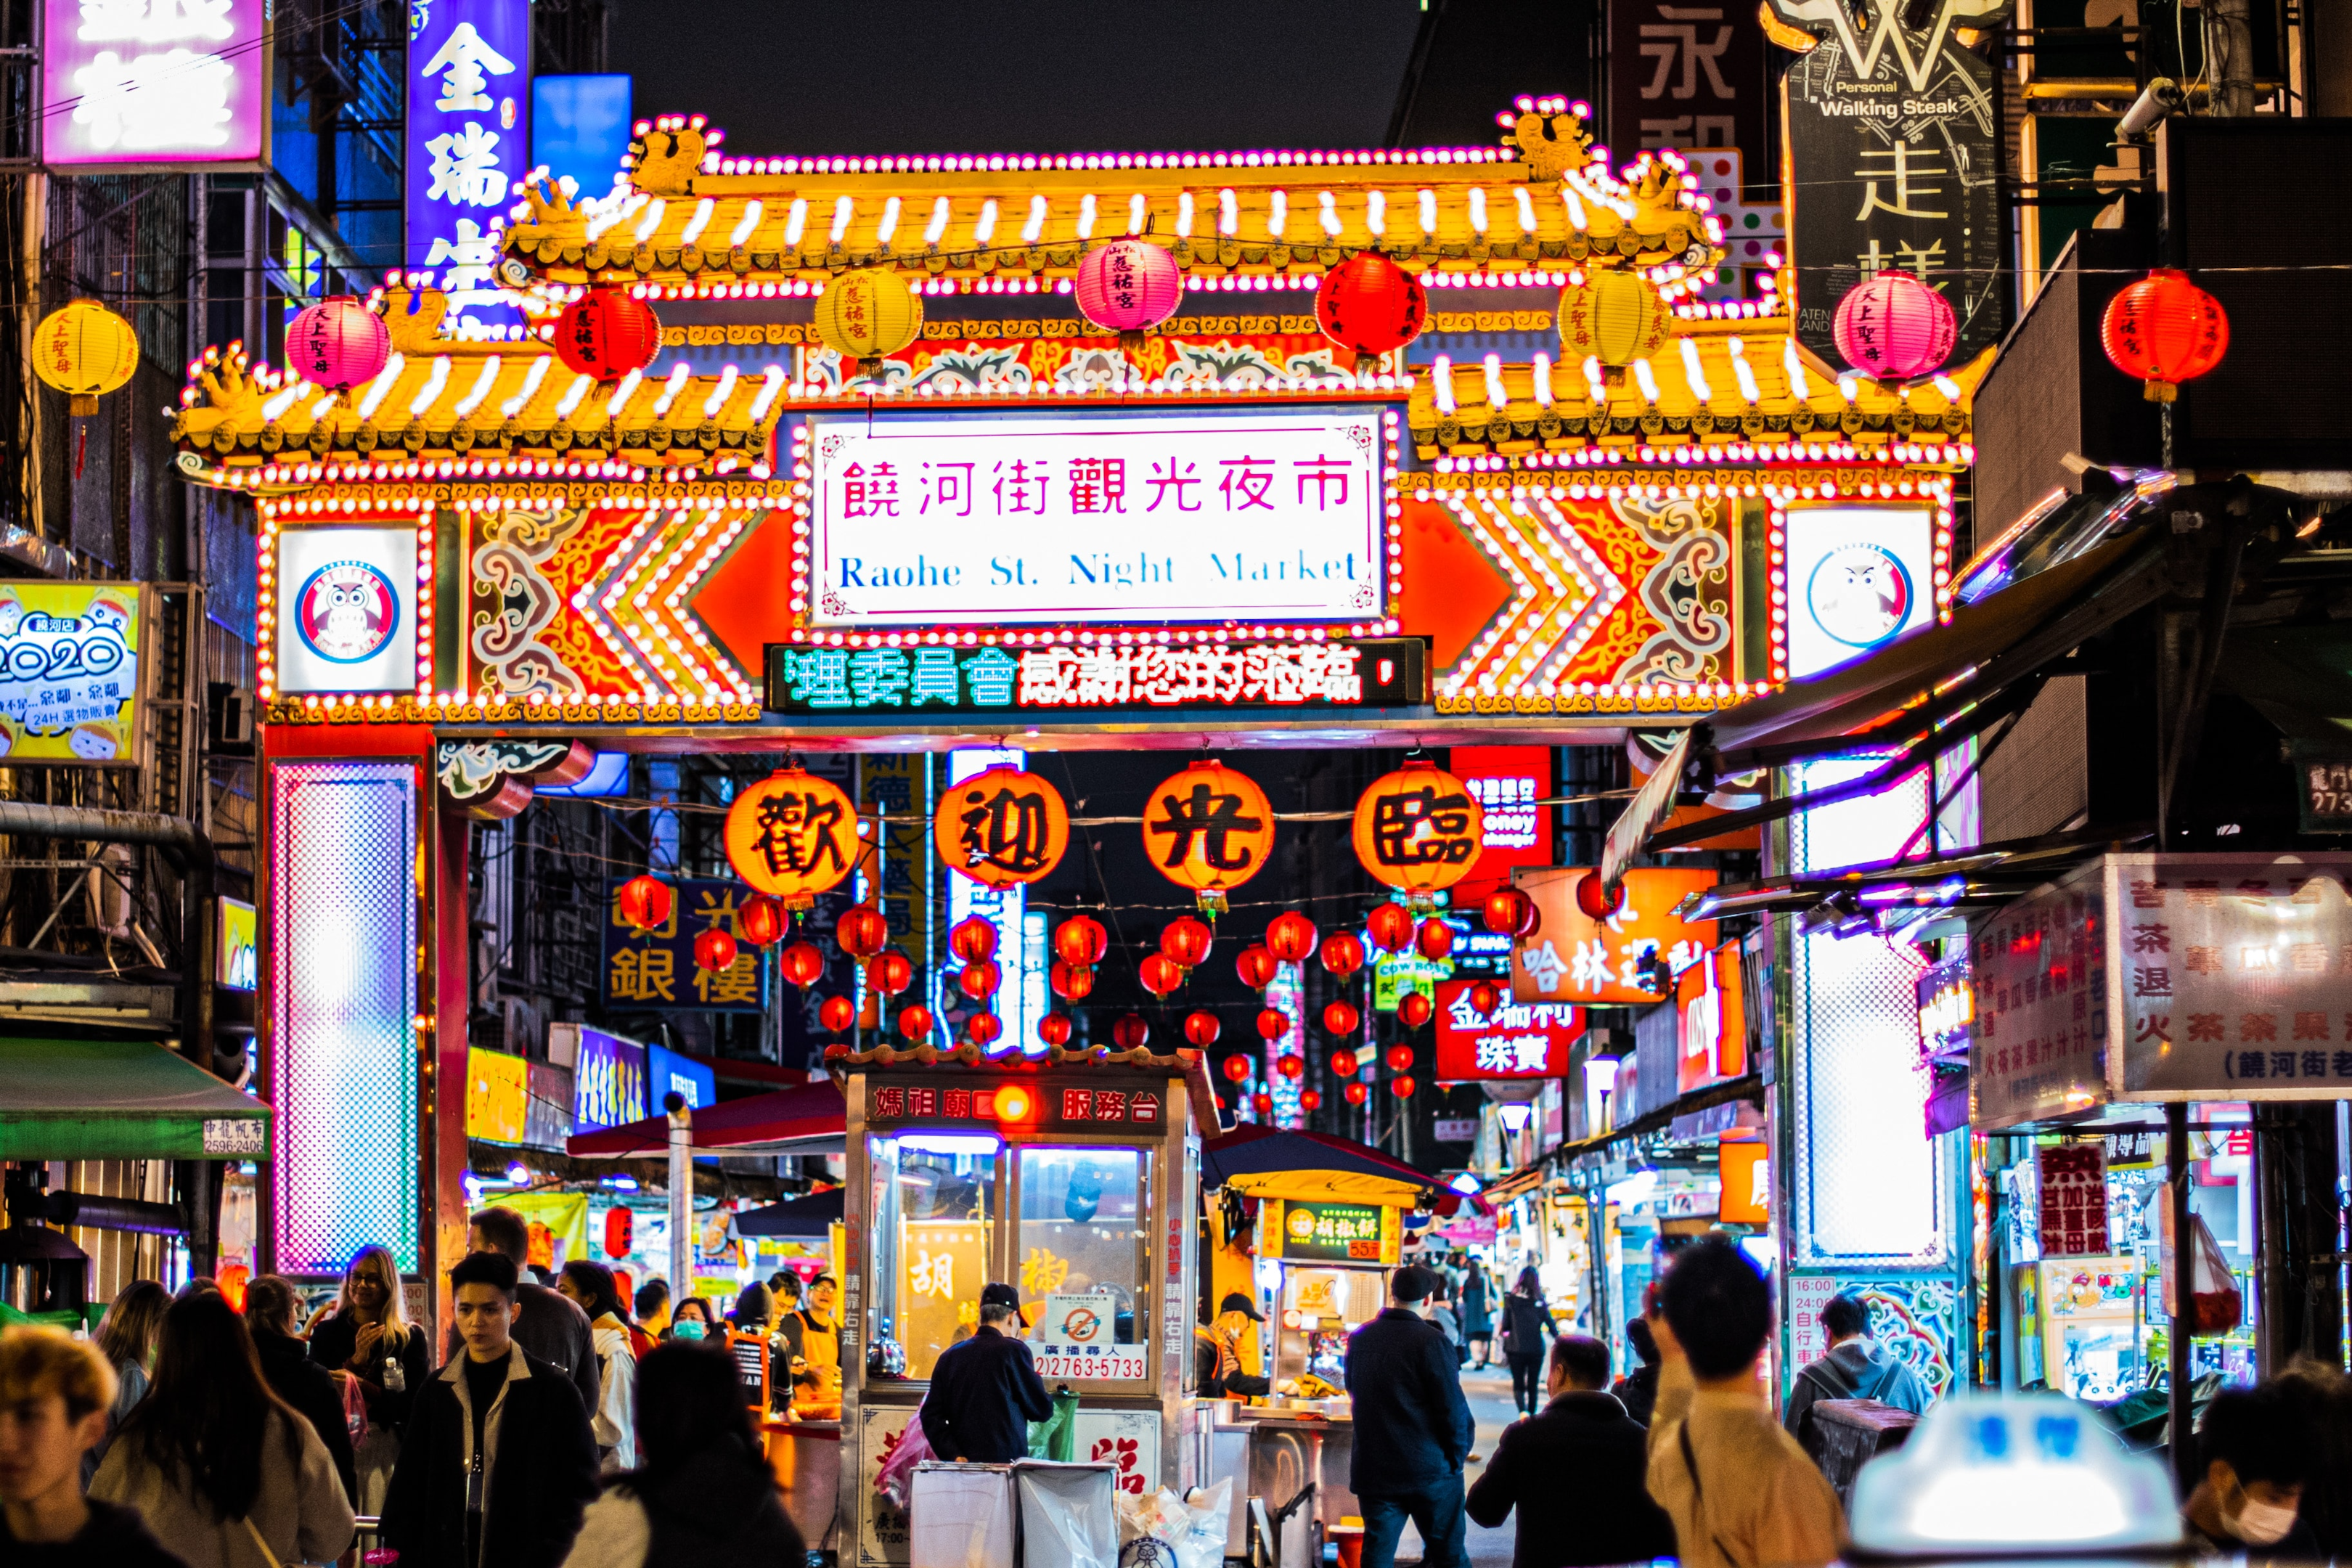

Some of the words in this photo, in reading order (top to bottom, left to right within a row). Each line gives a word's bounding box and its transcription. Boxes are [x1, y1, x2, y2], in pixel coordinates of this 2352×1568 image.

[1819, 98, 1898, 119] Walking
[1903, 98, 1959, 114] Steak
[1836, 81, 1898, 93] Personal
[1570, 279, 1594, 346] 天上聖母
[1856, 287, 1882, 362] 天上聖母
[52, 311, 73, 374] 天上聖母
[310, 308, 331, 375] 天上聖母
[843, 454, 1353, 520] 饒河街觀光夜市
[839, 555, 962, 589] Raohe
[991, 555, 1039, 587] St.
[1069, 553, 1175, 592] Night
[1211, 550, 1357, 582] Market
[33, 712, 59, 726] 24H
[2311, 766, 2352, 791] 龍門
[751, 791, 849, 878] 歡
[961, 788, 1050, 871] 迎
[1151, 783, 1263, 869] 光
[1374, 786, 1473, 865] 臨
[1482, 814, 1537, 834] oney
[611, 948, 759, 1003] 銀樓
[1379, 963, 1411, 976] COW
[1415, 963, 1451, 976] BOSS
[2130, 879, 2173, 1044] 苦茶退火
[1476, 1034, 1549, 1071] 珠寶
[205, 1119, 264, 1139] 申龍帆布
[1062, 1088, 1159, 1123] 服務台
[204, 1140, 264, 1153] 2596-2406
[910, 1249, 955, 1300] 胡
[1021, 1248, 1069, 1296] 椒
[1795, 1279, 1832, 1291] 16:00
[843, 1275, 861, 1346] 請靠右走
[1165, 1283, 1182, 1355] 請靠右走
[1044, 1344, 1120, 1356] 廣播尋人
[1796, 1311, 1812, 1365] 自行車
